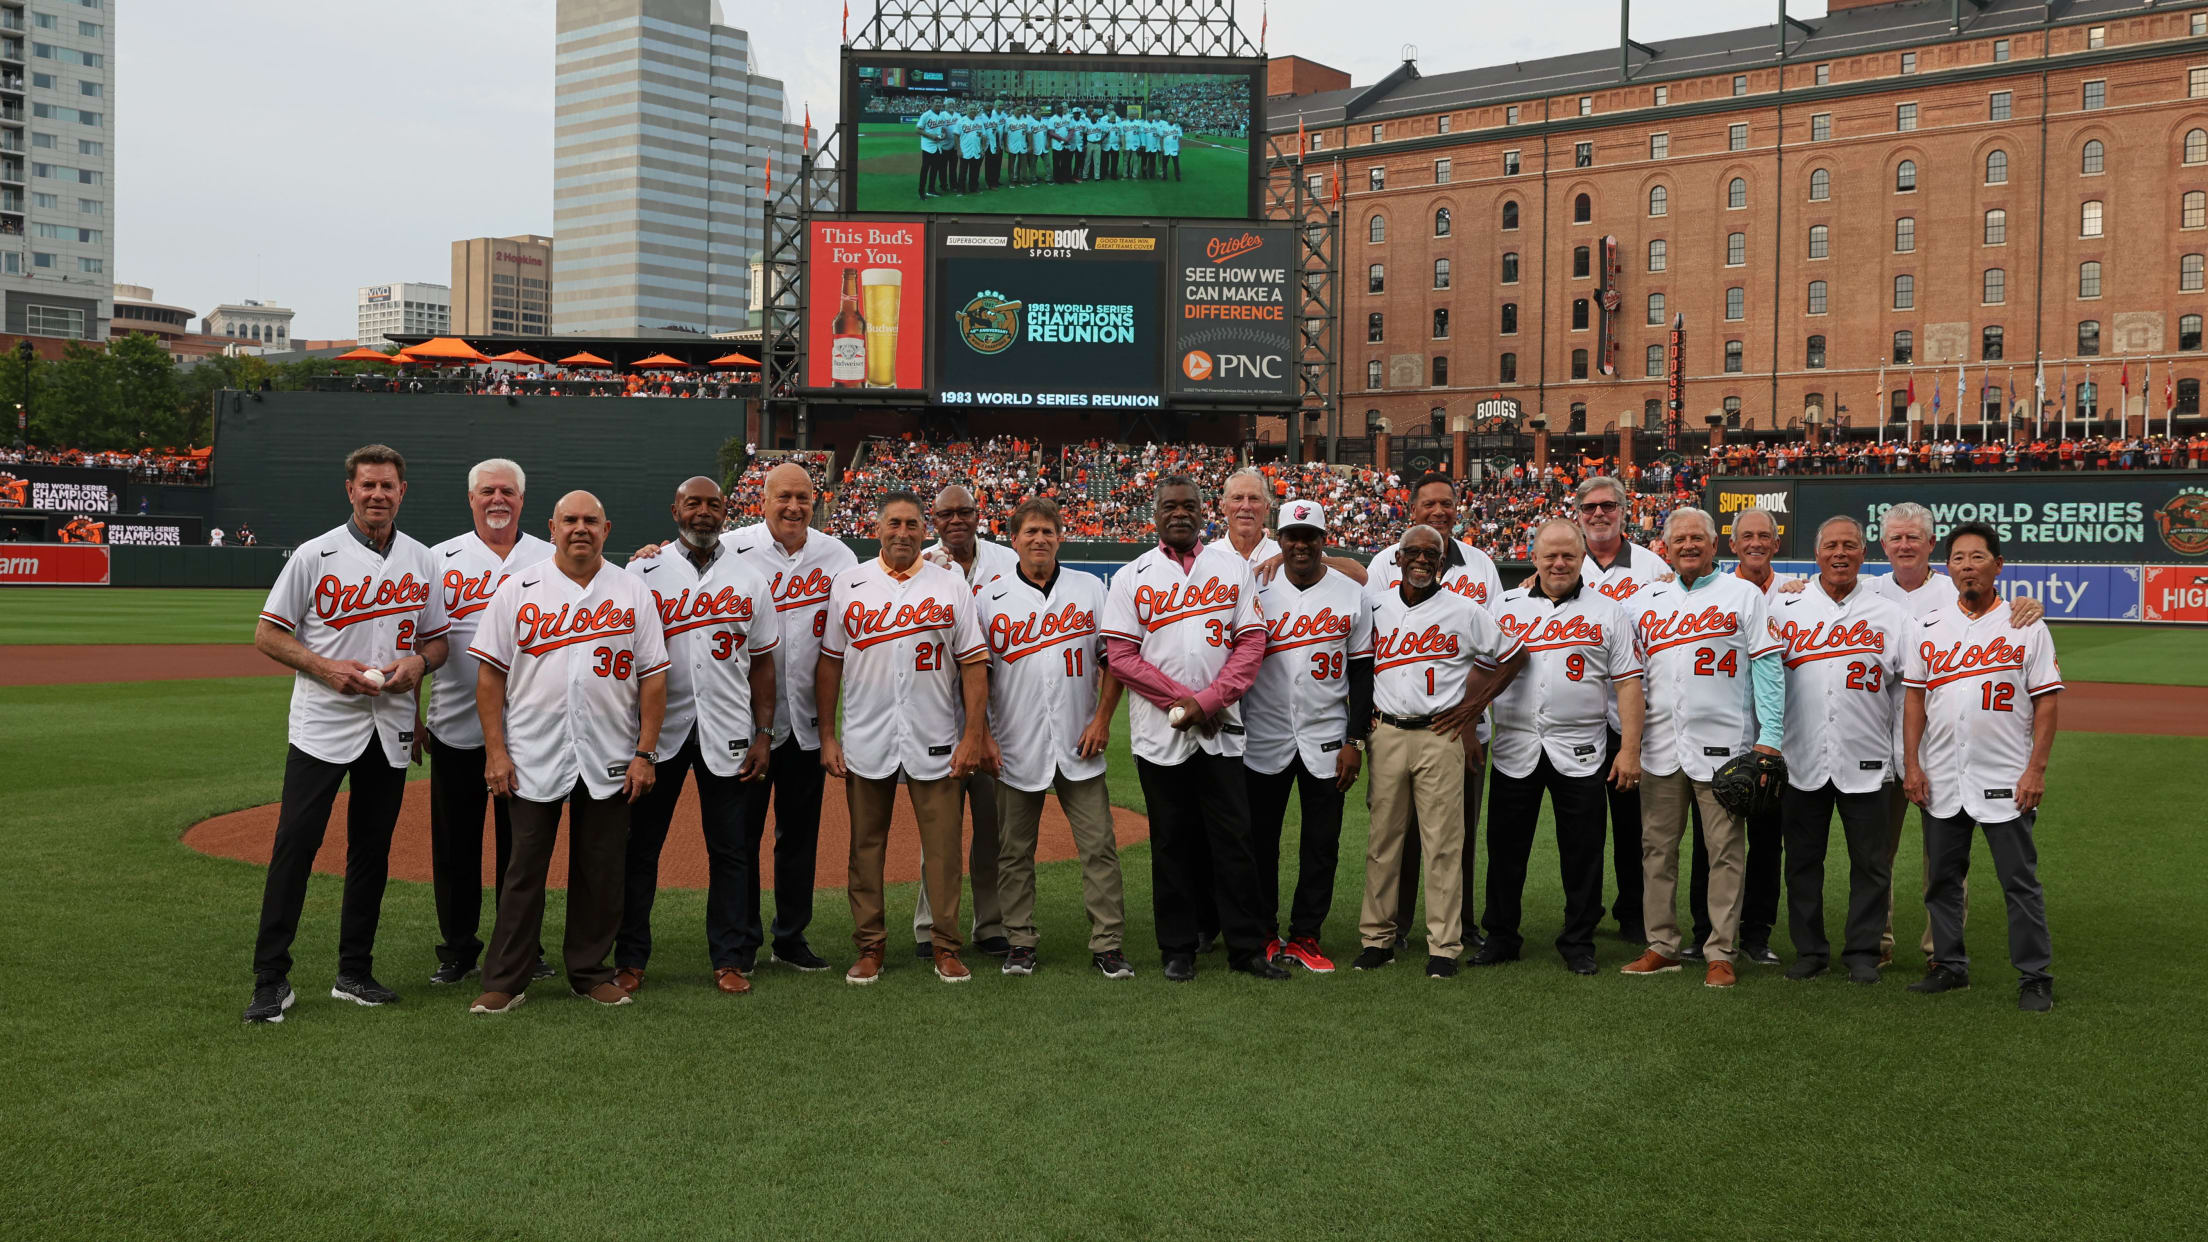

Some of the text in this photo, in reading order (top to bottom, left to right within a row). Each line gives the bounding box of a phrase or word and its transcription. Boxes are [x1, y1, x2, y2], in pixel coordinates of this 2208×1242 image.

[821, 227, 913, 245] This Bud's
[948, 237, 1007, 245] SUPERBOOK.COM
[1012, 226, 1090, 251] SUPERBOOK
[1206, 232, 1264, 258] Orioles
[495, 250, 544, 267] 2 Hopkins
[832, 247, 903, 265] For You.
[1029, 249, 1072, 258] SPORTS
[1185, 267, 1286, 284] SEE HOW WE
[1186, 285, 1283, 302] CAN MAKE A
[1027, 303, 1134, 314] 1983 WORLD SERIES
[1027, 311, 1134, 327] CHAMPIONS
[1184, 304, 1285, 321] DIFFERENCE
[1027, 325, 1135, 344] REUNION
[1216, 354, 1283, 379] PNC
[941, 391, 1159, 407] 1983 WORLD SERIES REUNION
[1477, 399, 1517, 420] BOOG'S
[32, 488, 109, 501] CHAMPIONS
[51, 483, 80, 491] WORLD
[81, 484, 108, 492] SERIES
[32, 498, 109, 513] REUNION
[1719, 491, 1788, 513] SUPERBOOK
[1930, 503, 2034, 524] WORLD
[2041, 502, 2145, 523] SERIES
[108, 530, 180, 542] CHAMPIONS
[125, 525, 153, 533] WORLD
[2021, 523, 2145, 543] REUNION
[0, 556, 39, 575] arm
[315, 572, 430, 619] Orioles
[1134, 575, 1240, 626] Orioles
[1994, 572, 2089, 613] inity
[516, 599, 636, 648] Orioles
[812, 609, 828, 638] 8
[844, 596, 955, 640] Orioles
[989, 602, 1096, 654] Orioles
[1265, 606, 1352, 644] rioles
[1638, 605, 1739, 649] Orioles
[395, 619, 415, 651] 2
[711, 630, 748, 664] 37
[1781, 619, 1885, 660] Orioles
[592, 646, 635, 681] 36
[915, 641, 945, 672] 21
[1063, 646, 1084, 678] 11
[1310, 650, 1344, 681] 39
[1565, 653, 1586, 682] 9
[1694, 646, 1739, 679] 24
[1424, 666, 1436, 696] 1
[1845, 660, 1884, 694] 23
[1981, 680, 2016, 713] 12
